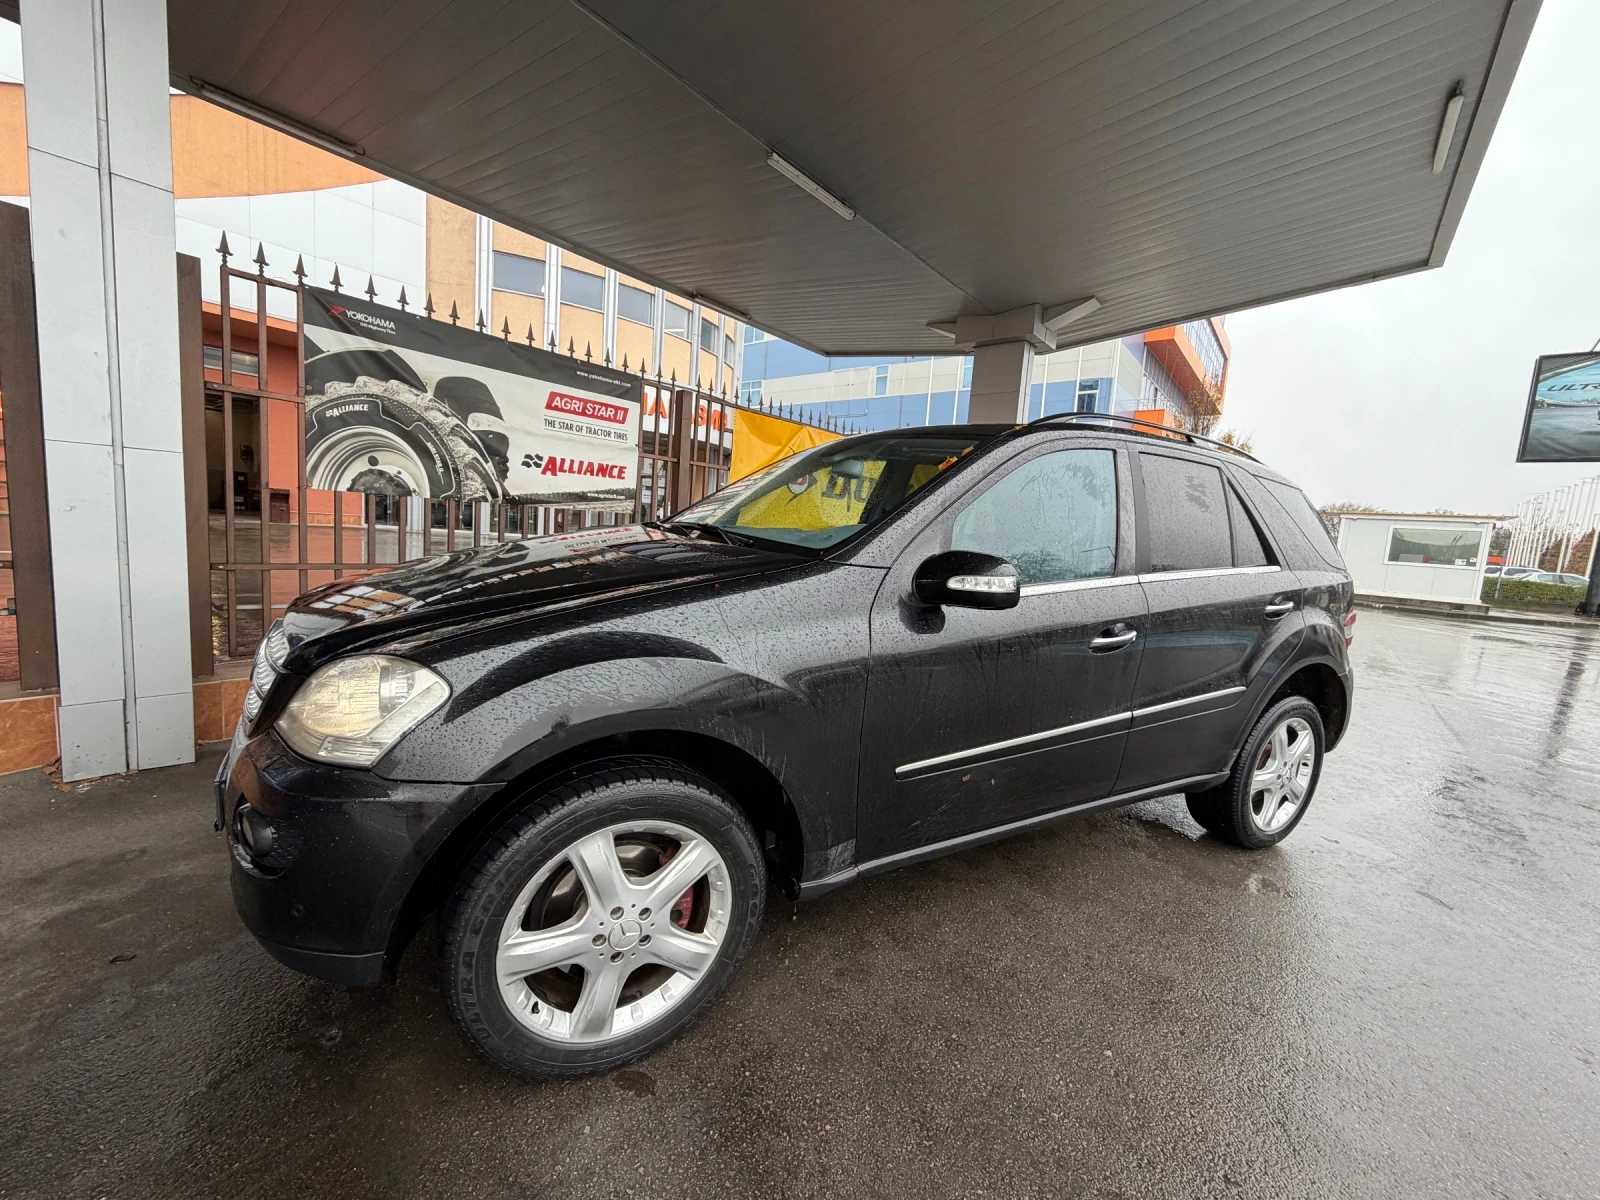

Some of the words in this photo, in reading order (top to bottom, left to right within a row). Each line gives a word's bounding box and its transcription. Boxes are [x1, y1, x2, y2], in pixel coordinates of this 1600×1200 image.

[345, 309, 396, 330] YOKOHAMA
[359, 322, 387, 333] Off-Highway
[332, 404, 369, 417] ALLIANCE
[551, 396, 584, 413] AGRI
[585, 403, 616, 419] STAR
[616, 410, 625, 421] II
[544, 418, 556, 429] THE
[558, 421, 574, 432] STAR
[575, 425, 584, 433] OF
[585, 426, 612, 438] TRACTOR
[613, 431, 628, 441] TIRES
[540, 455, 628, 480] ALLIANCE
